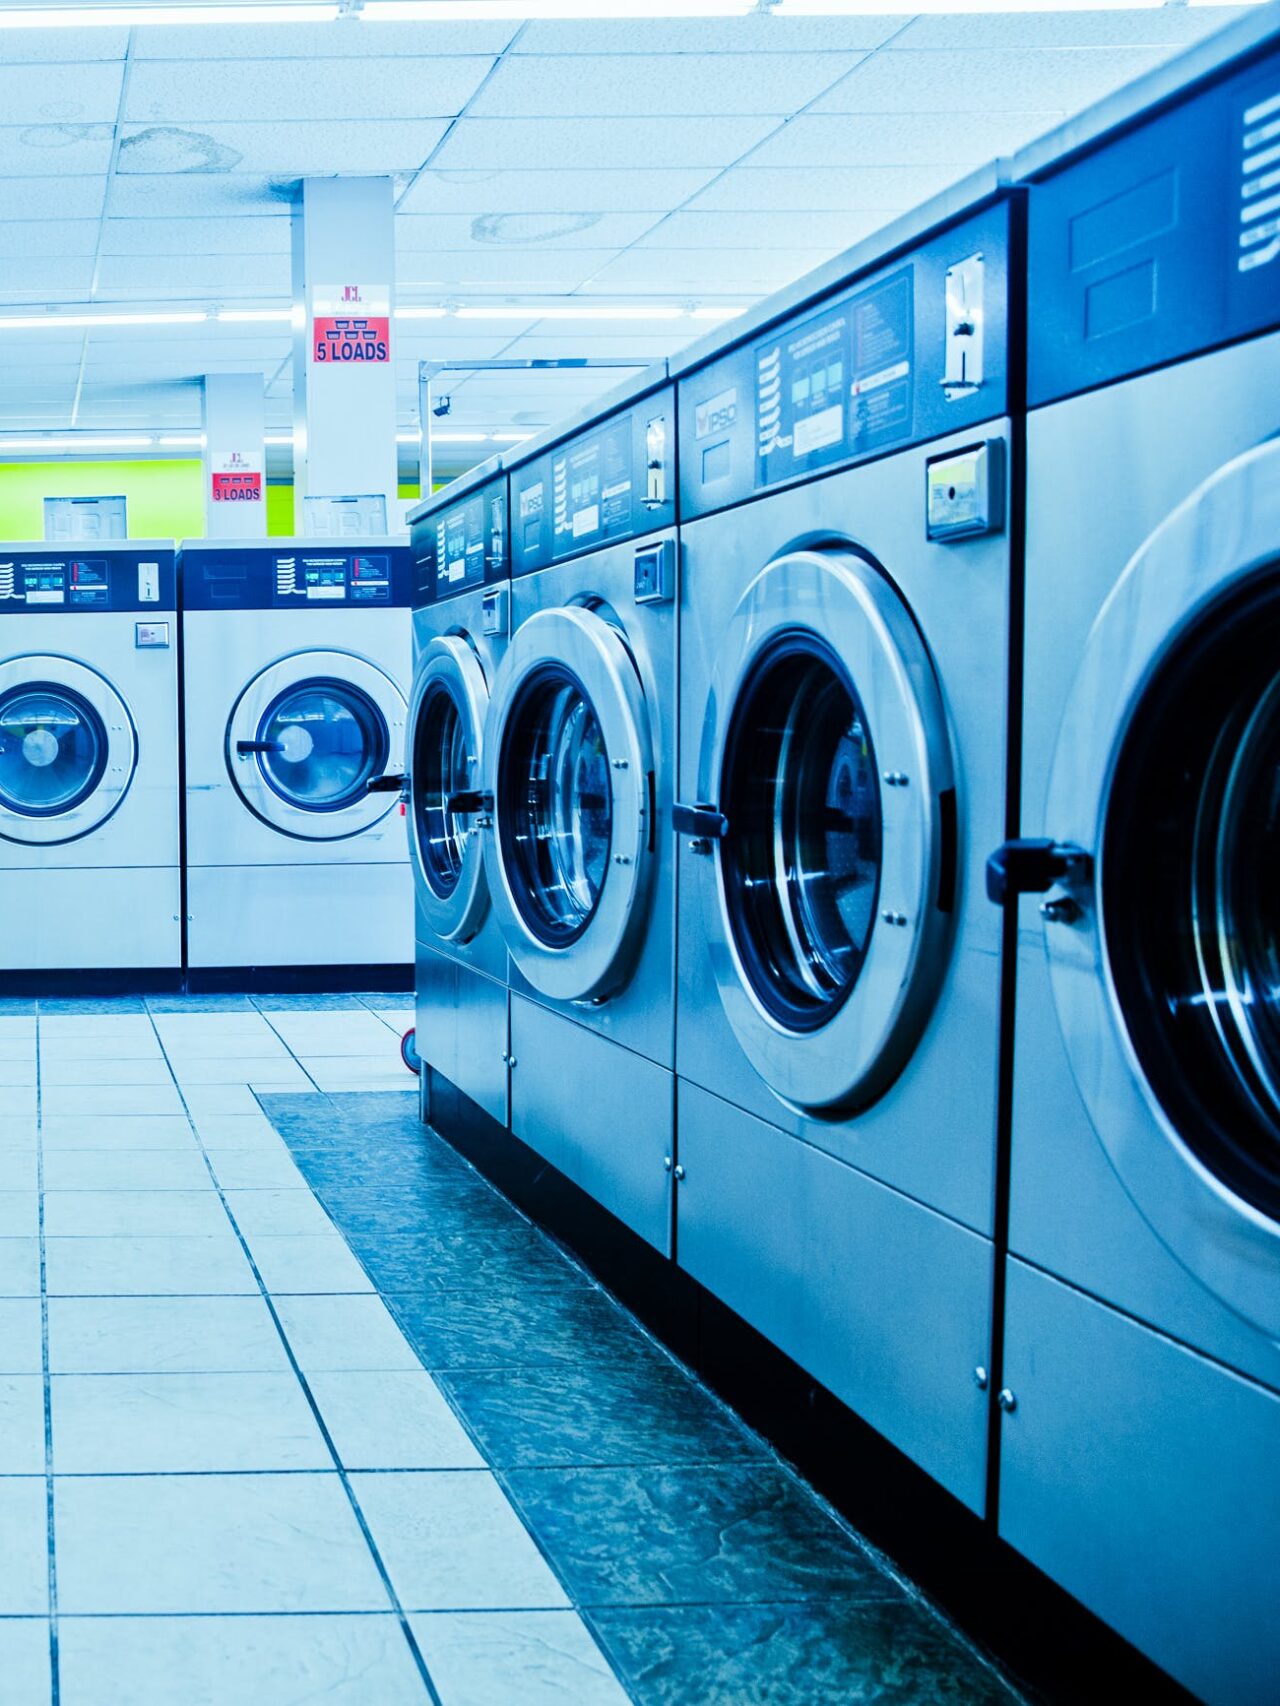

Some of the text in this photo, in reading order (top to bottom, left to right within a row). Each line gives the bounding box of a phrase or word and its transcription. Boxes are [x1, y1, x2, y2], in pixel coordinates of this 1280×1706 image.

[317, 342, 387, 361] 5 LOADS
[708, 403, 737, 432] IPSO
[215, 488, 260, 501] 3 LOADS
